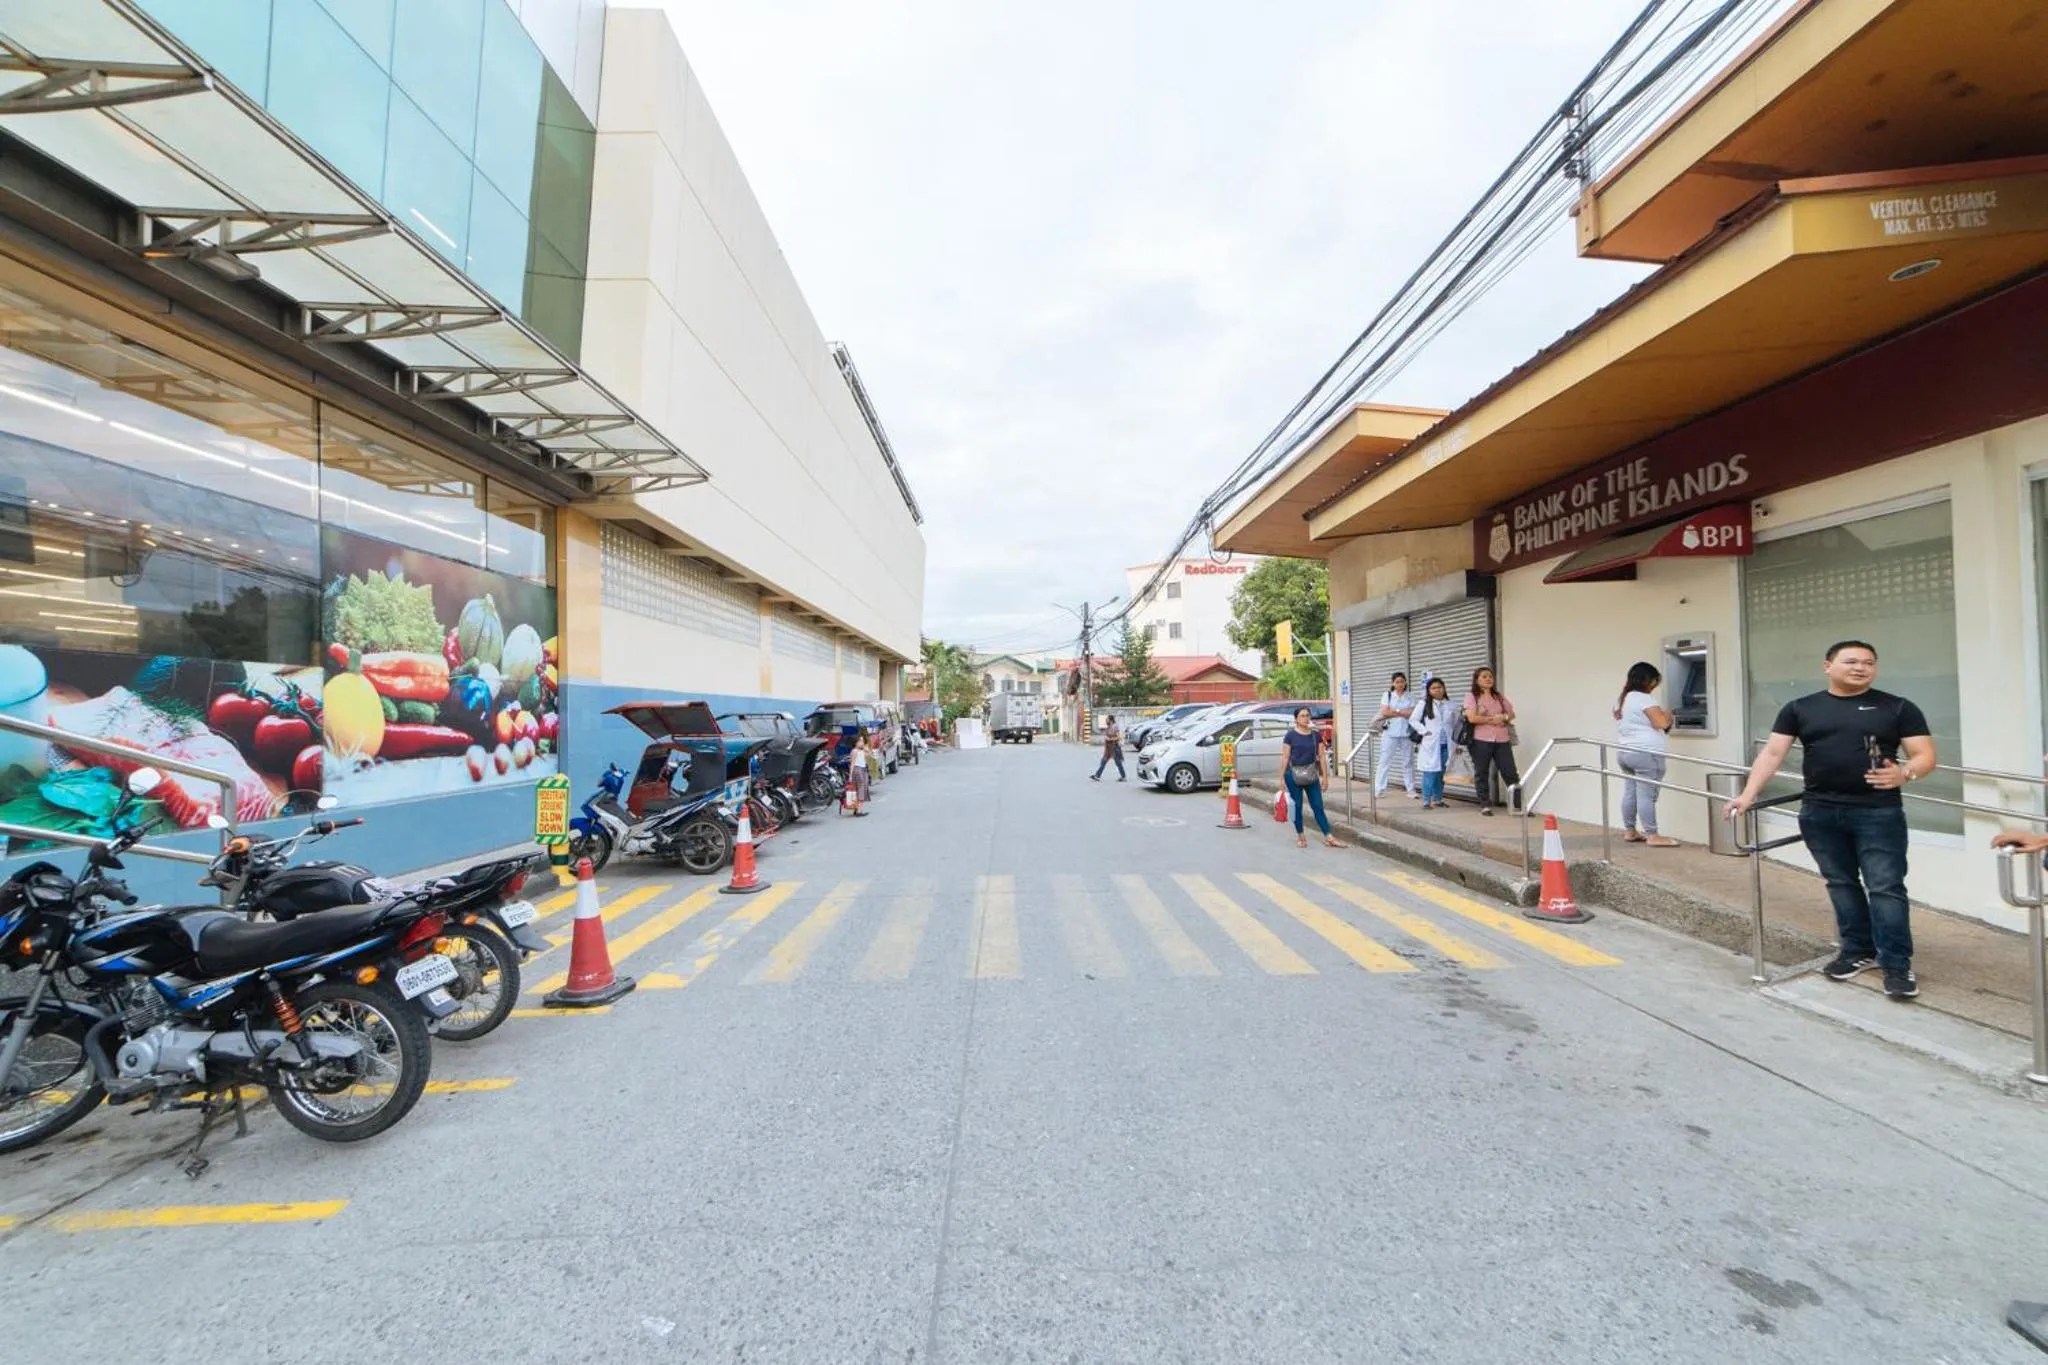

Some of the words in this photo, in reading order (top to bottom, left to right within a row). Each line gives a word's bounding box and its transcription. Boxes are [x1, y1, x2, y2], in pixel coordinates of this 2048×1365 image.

[1870, 198, 1926, 220] VERTICAL
[1929, 190, 1998, 214] CLEARANCE
[1514, 490, 1566, 530] BANK
[1571, 478, 1599, 507] OF
[1604, 457, 1649, 496] THE
[1514, 498, 1620, 555] PHILIPPINE
[1628, 453, 1750, 519] ISLANDS
[1702, 525, 1743, 547] BPI
[539, 823, 562, 833] DOWN
[540, 812, 562, 822] SLOW
